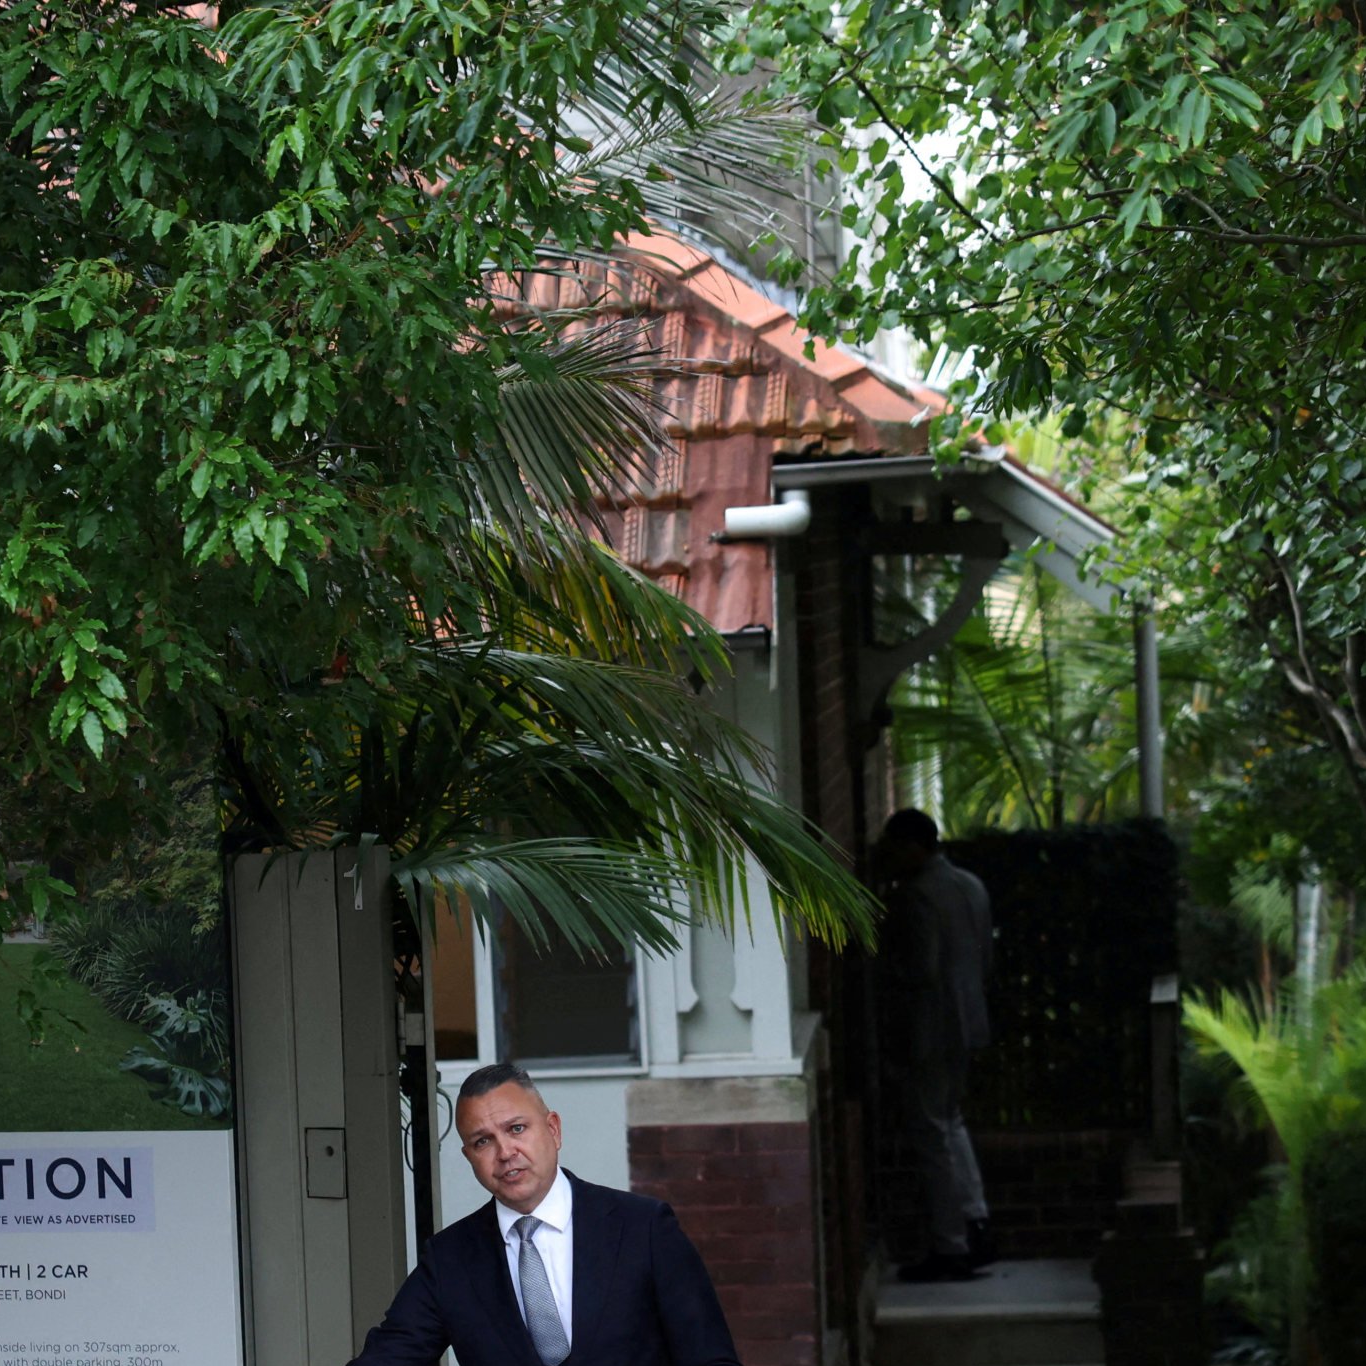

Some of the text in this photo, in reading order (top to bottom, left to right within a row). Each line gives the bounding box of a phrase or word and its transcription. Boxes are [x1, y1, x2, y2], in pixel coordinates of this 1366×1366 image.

[14, 1216, 44, 1224] VIEW
[48, 1215, 62, 1224] AS
[66, 1214, 135, 1224] ADVERTISED
[37, 1265, 46, 1278] 2
[52, 1265, 88, 1278] CAR
[26, 1289, 65, 1300] BONDI
[30, 1342, 61, 1355] living
[64, 1344, 80, 1353] on
[83, 1342, 132, 1355] 307sqm
